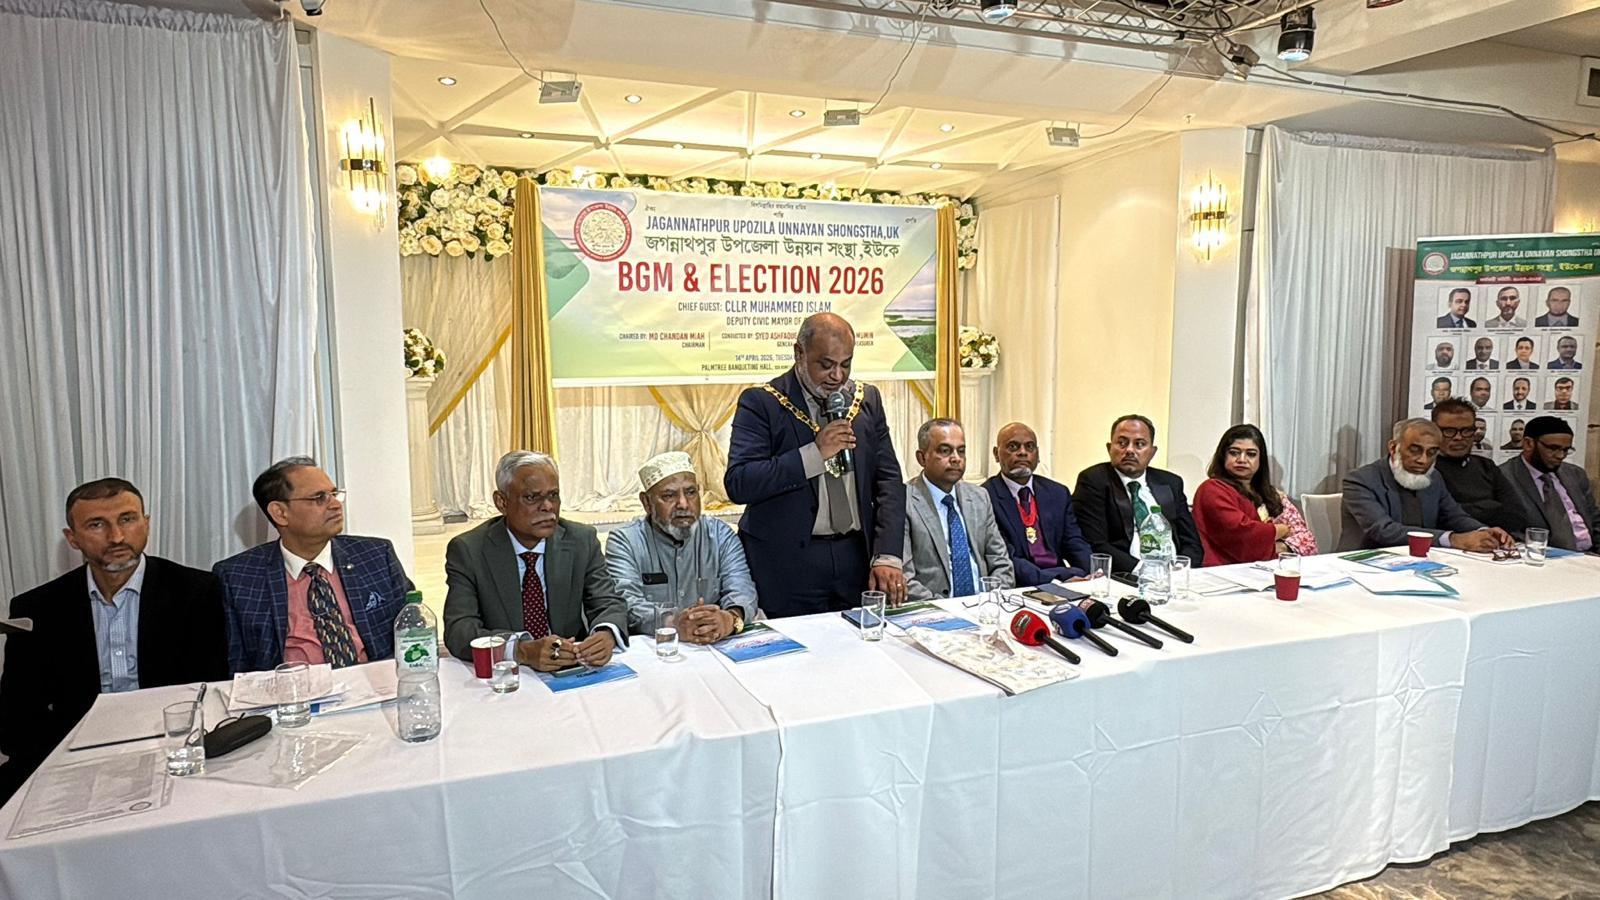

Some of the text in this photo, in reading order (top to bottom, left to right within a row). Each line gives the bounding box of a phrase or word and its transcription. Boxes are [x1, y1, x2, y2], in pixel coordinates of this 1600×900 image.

[646, 216, 899, 240] JAGANNATHPUR UPOZILA UNNAYAN SHONGSTHA,UK
[644, 234, 717, 256] জগন্নাথপুর
[721, 234, 780, 254] উপজেলা
[783, 236, 822, 258] উন্নয়ন
[1450, 251, 1497, 260] JAGANNATHPUR
[1525, 249, 1554, 258] UNNAYAN
[1556, 248, 1593, 257] SHONGSTHA
[619, 261, 884, 295] BGM & ELECTION 2026
[678, 300, 832, 313] CHIEF GUEST: CLLR MUHAMMED ISLAM
[726, 317, 751, 326] DEPUTY
[752, 317, 770, 326] CIVIC
[771, 317, 793, 326] MAYOR
[649, 332, 658, 340] MD
[660, 332, 688, 340] CHANDAN
[690, 332, 705, 340] MIAH
[755, 332, 769, 340] SYED
